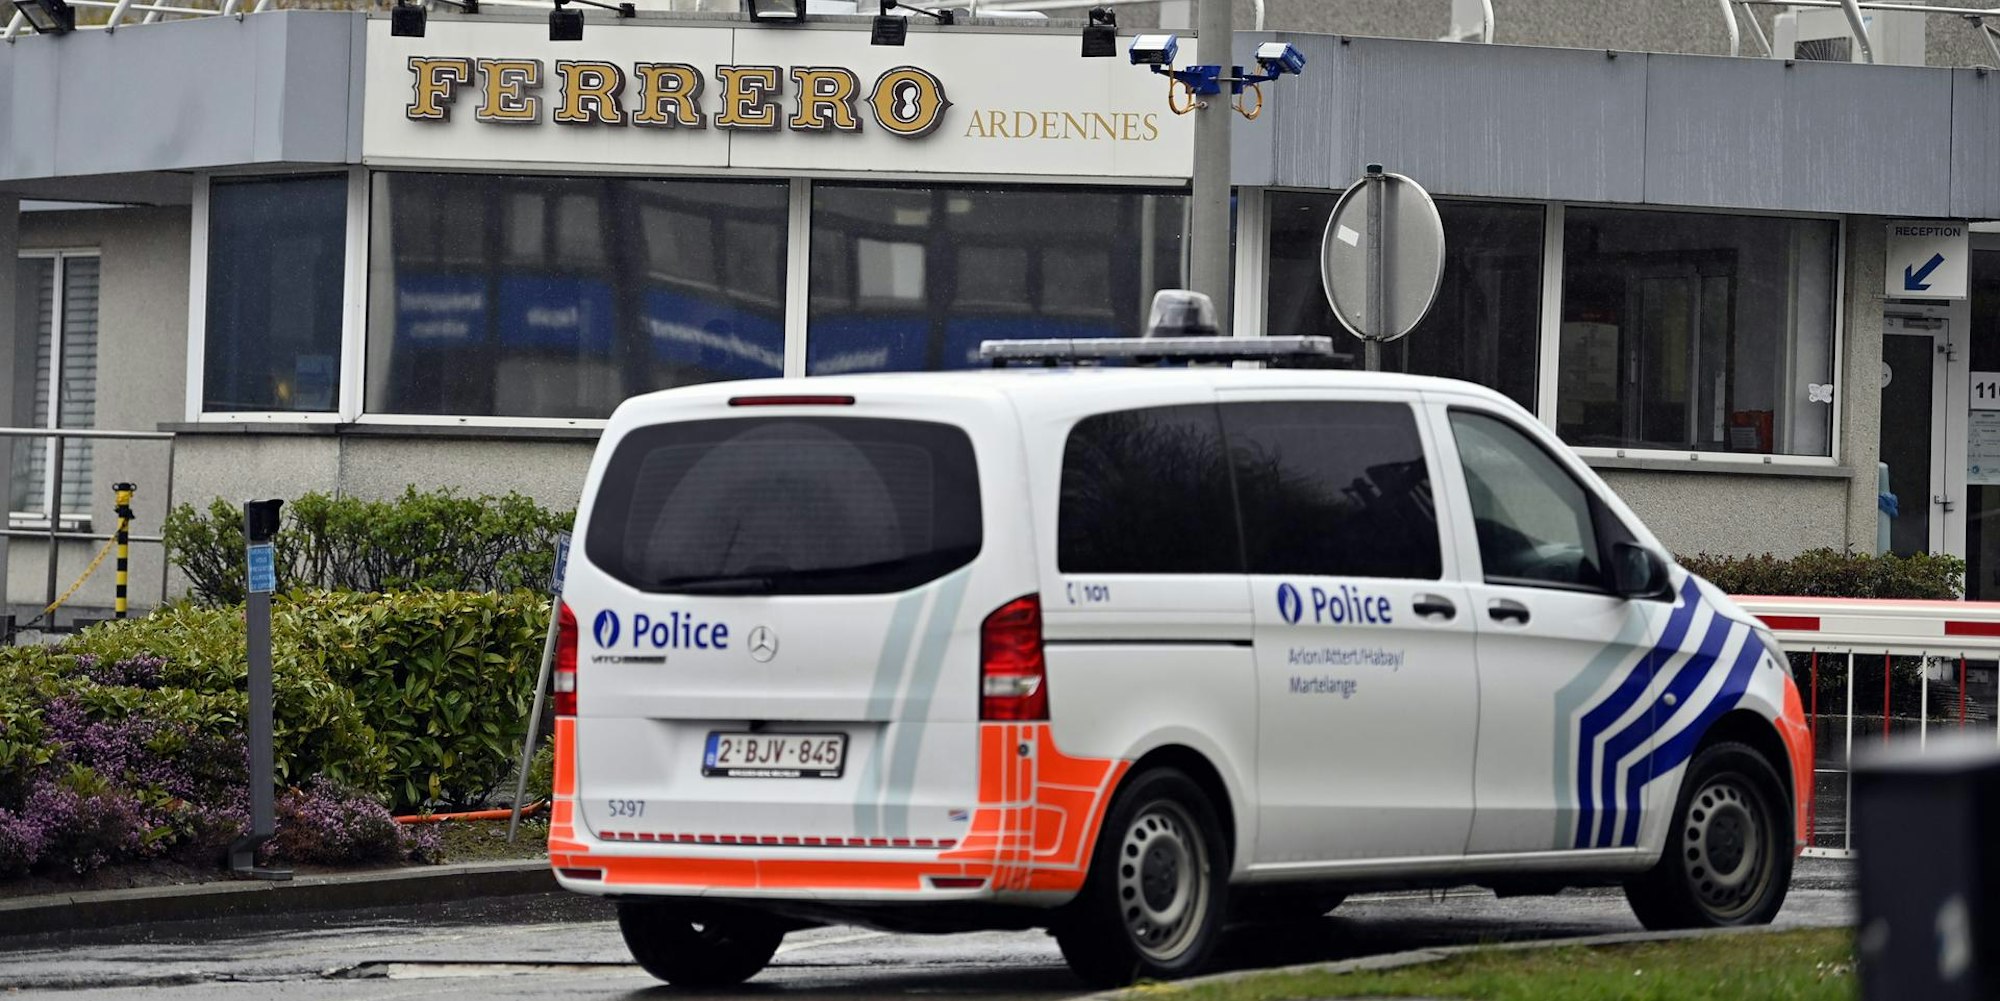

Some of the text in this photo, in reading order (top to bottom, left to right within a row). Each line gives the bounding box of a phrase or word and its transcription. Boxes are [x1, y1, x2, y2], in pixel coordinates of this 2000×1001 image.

[405, 54, 1159, 142] FERRERO ARDENNES
[1895, 226, 1961, 238] RECEPTION
[1975, 381, 2000, 399] 11
[1084, 585, 1110, 603] 101
[1311, 584, 1393, 625] Police
[633, 611, 729, 650] Police
[1288, 675, 1358, 699] Martelange
[608, 799, 646, 817] 5297
